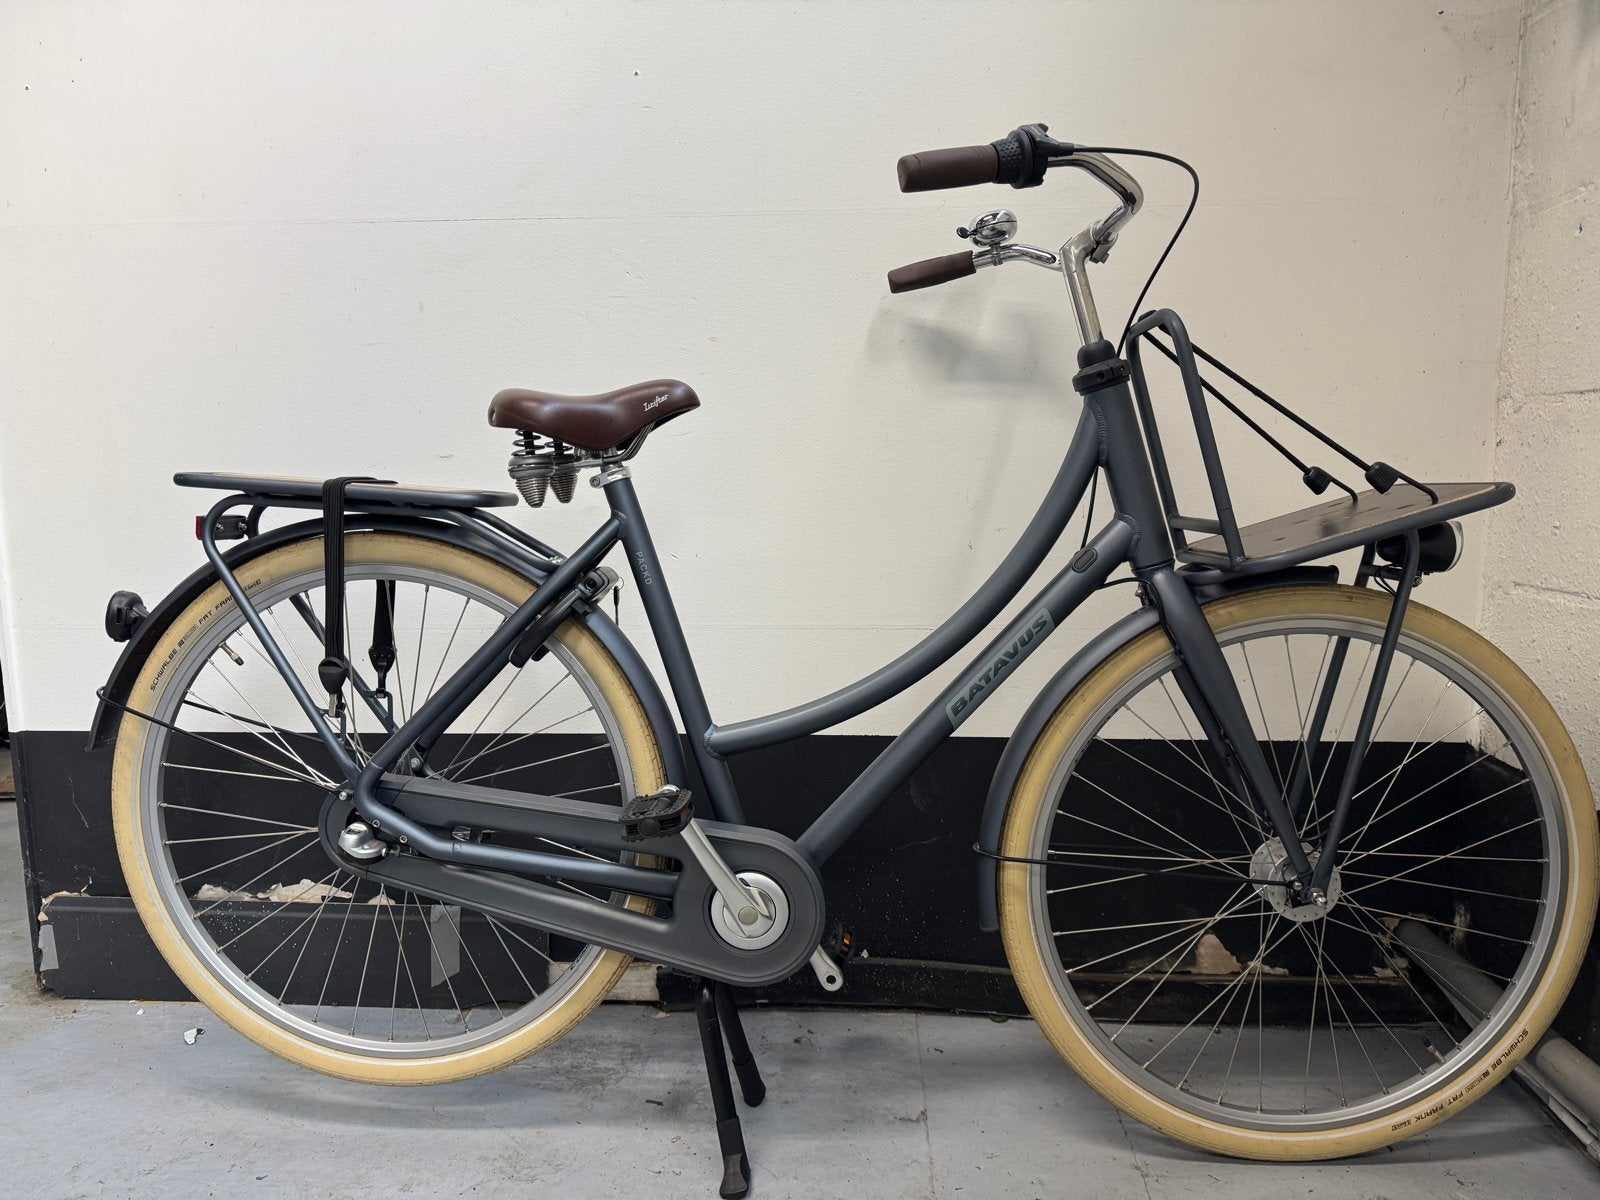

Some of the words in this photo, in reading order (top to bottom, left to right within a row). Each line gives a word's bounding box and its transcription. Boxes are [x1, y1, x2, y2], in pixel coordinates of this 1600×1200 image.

[635, 551, 652, 585] PACKD
[150, 648, 178, 691] SCHWALBE
[198, 610, 213, 625] FAT
[951, 615, 1048, 717] BATAVUS
[1491, 1028, 1529, 1071] SCHWALBE
[1415, 1104, 1444, 1123] FRANK
[1447, 1091, 1464, 1106] FAT
